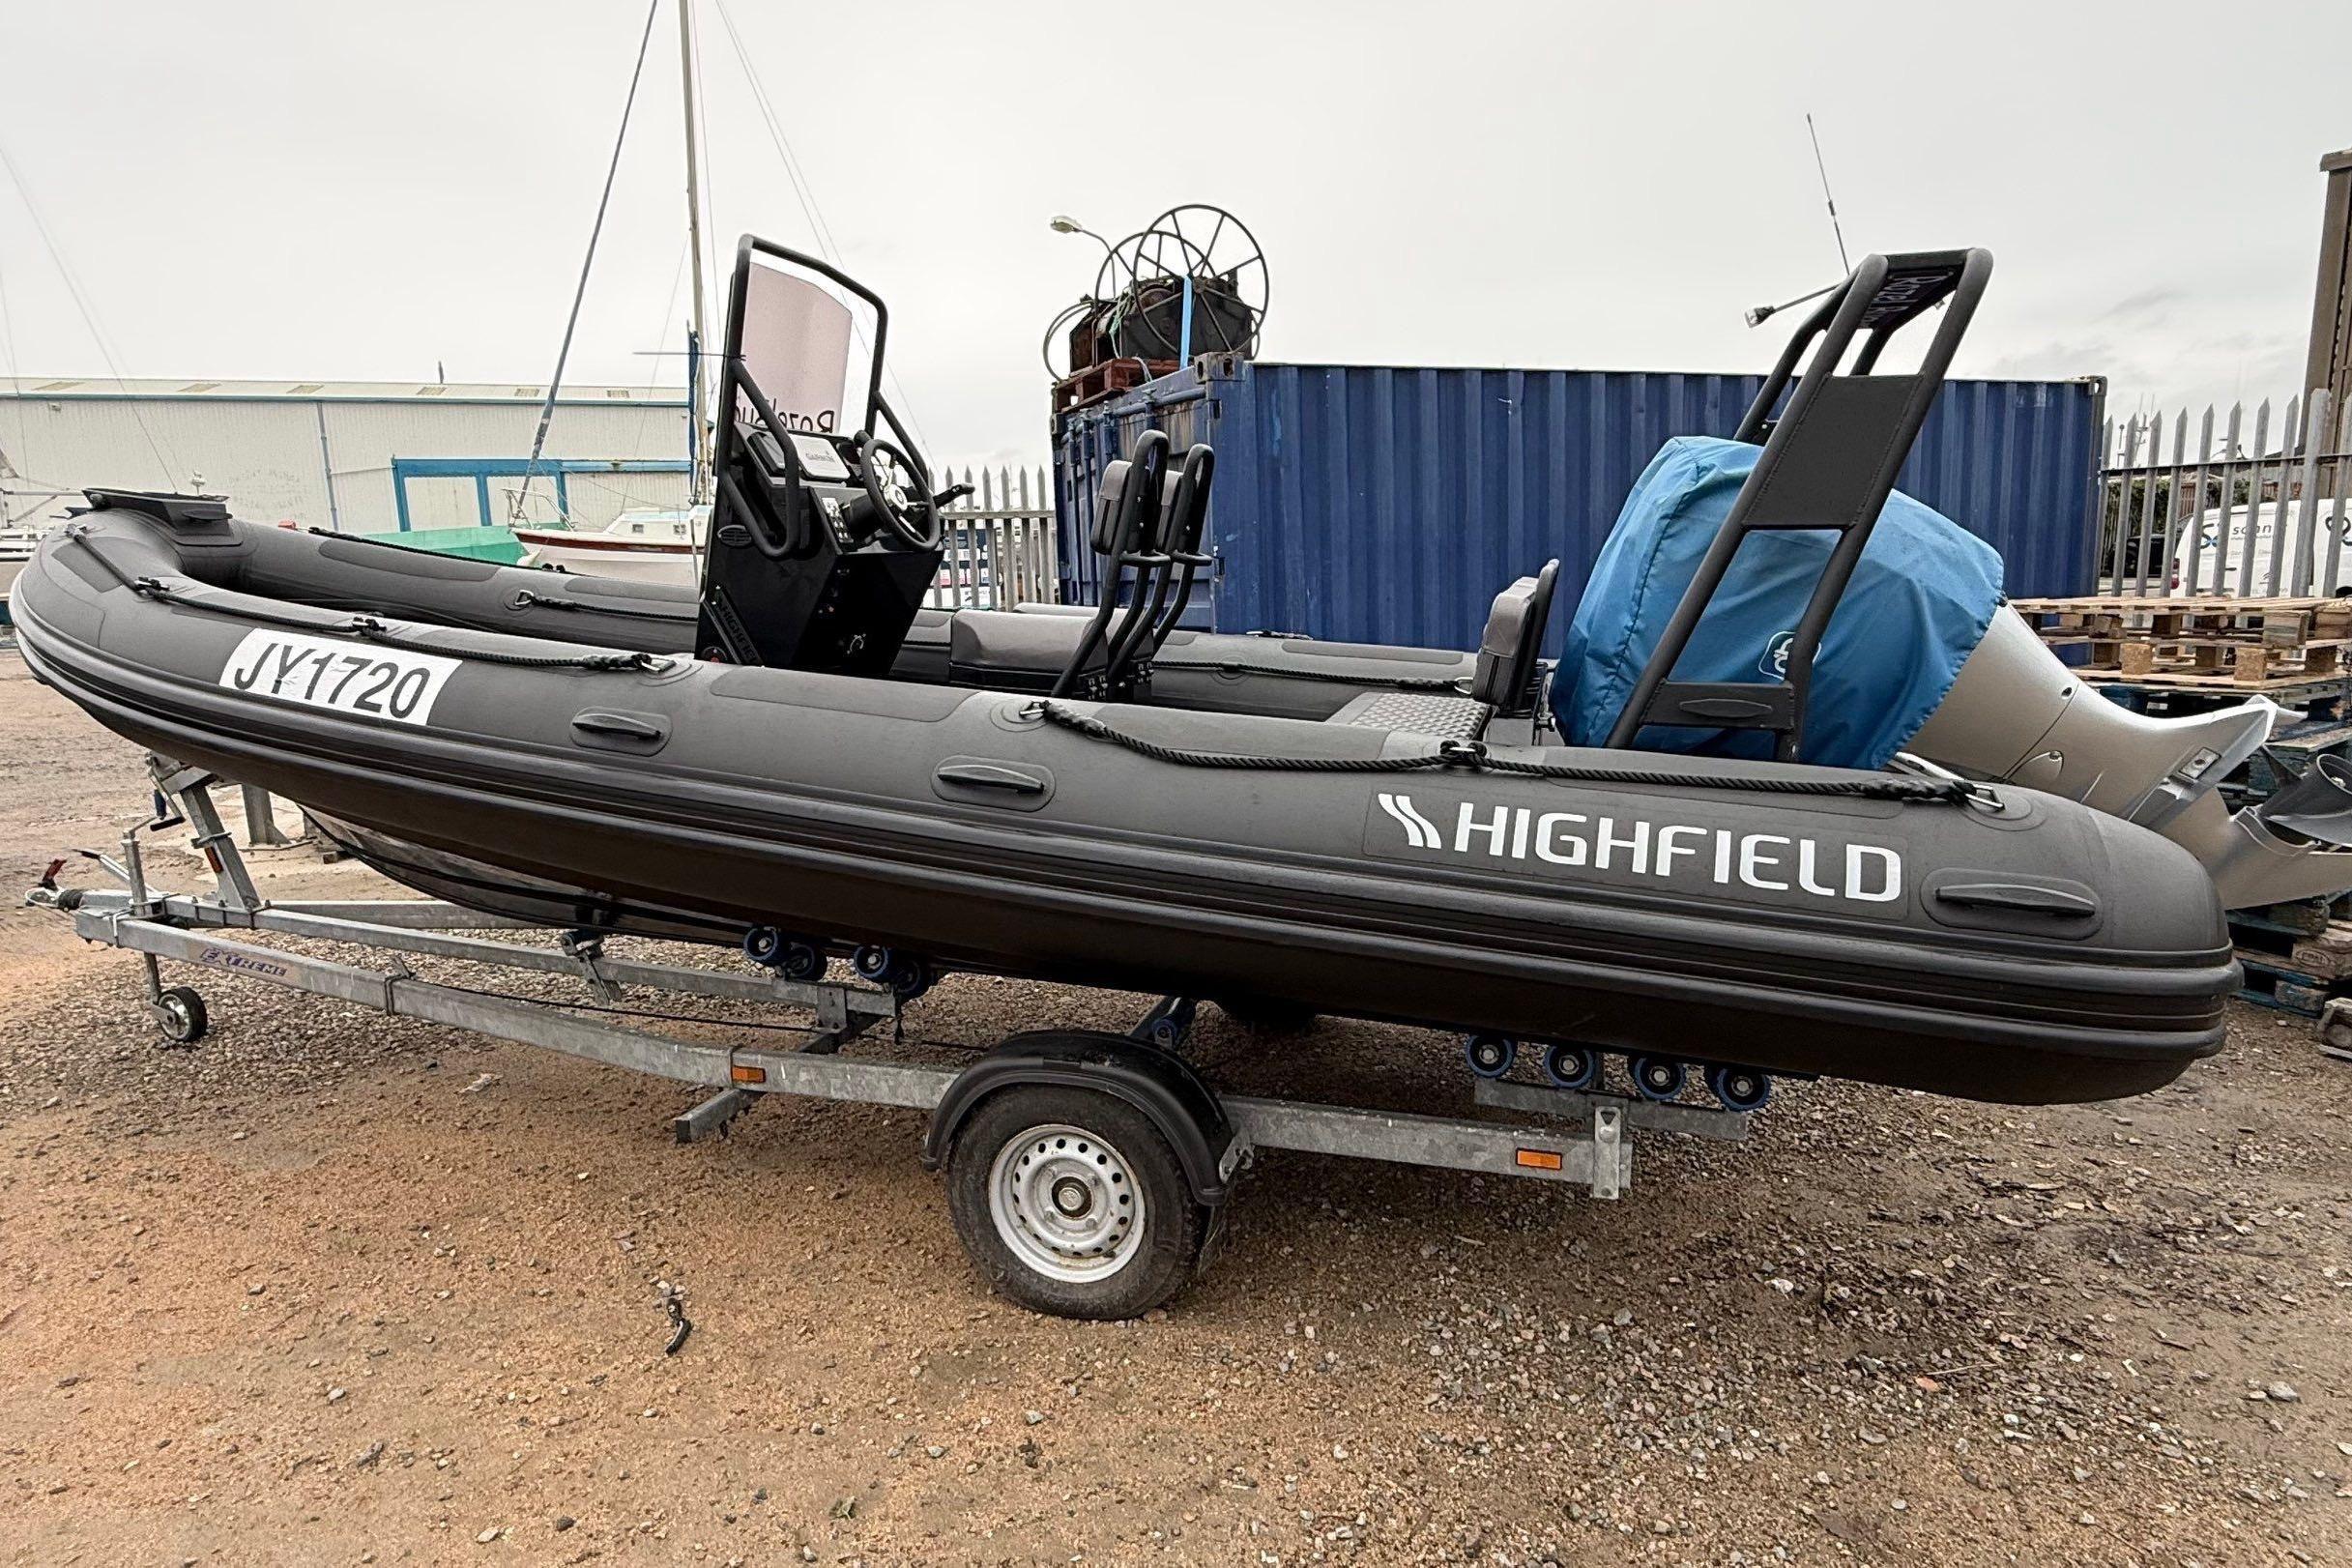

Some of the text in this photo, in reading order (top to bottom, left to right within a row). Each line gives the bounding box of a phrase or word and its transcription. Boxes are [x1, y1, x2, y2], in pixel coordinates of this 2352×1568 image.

[233, 642, 431, 719] JY1720
[1454, 801, 1902, 902] HIGHFIELD
[200, 948, 287, 976] EXTREME
